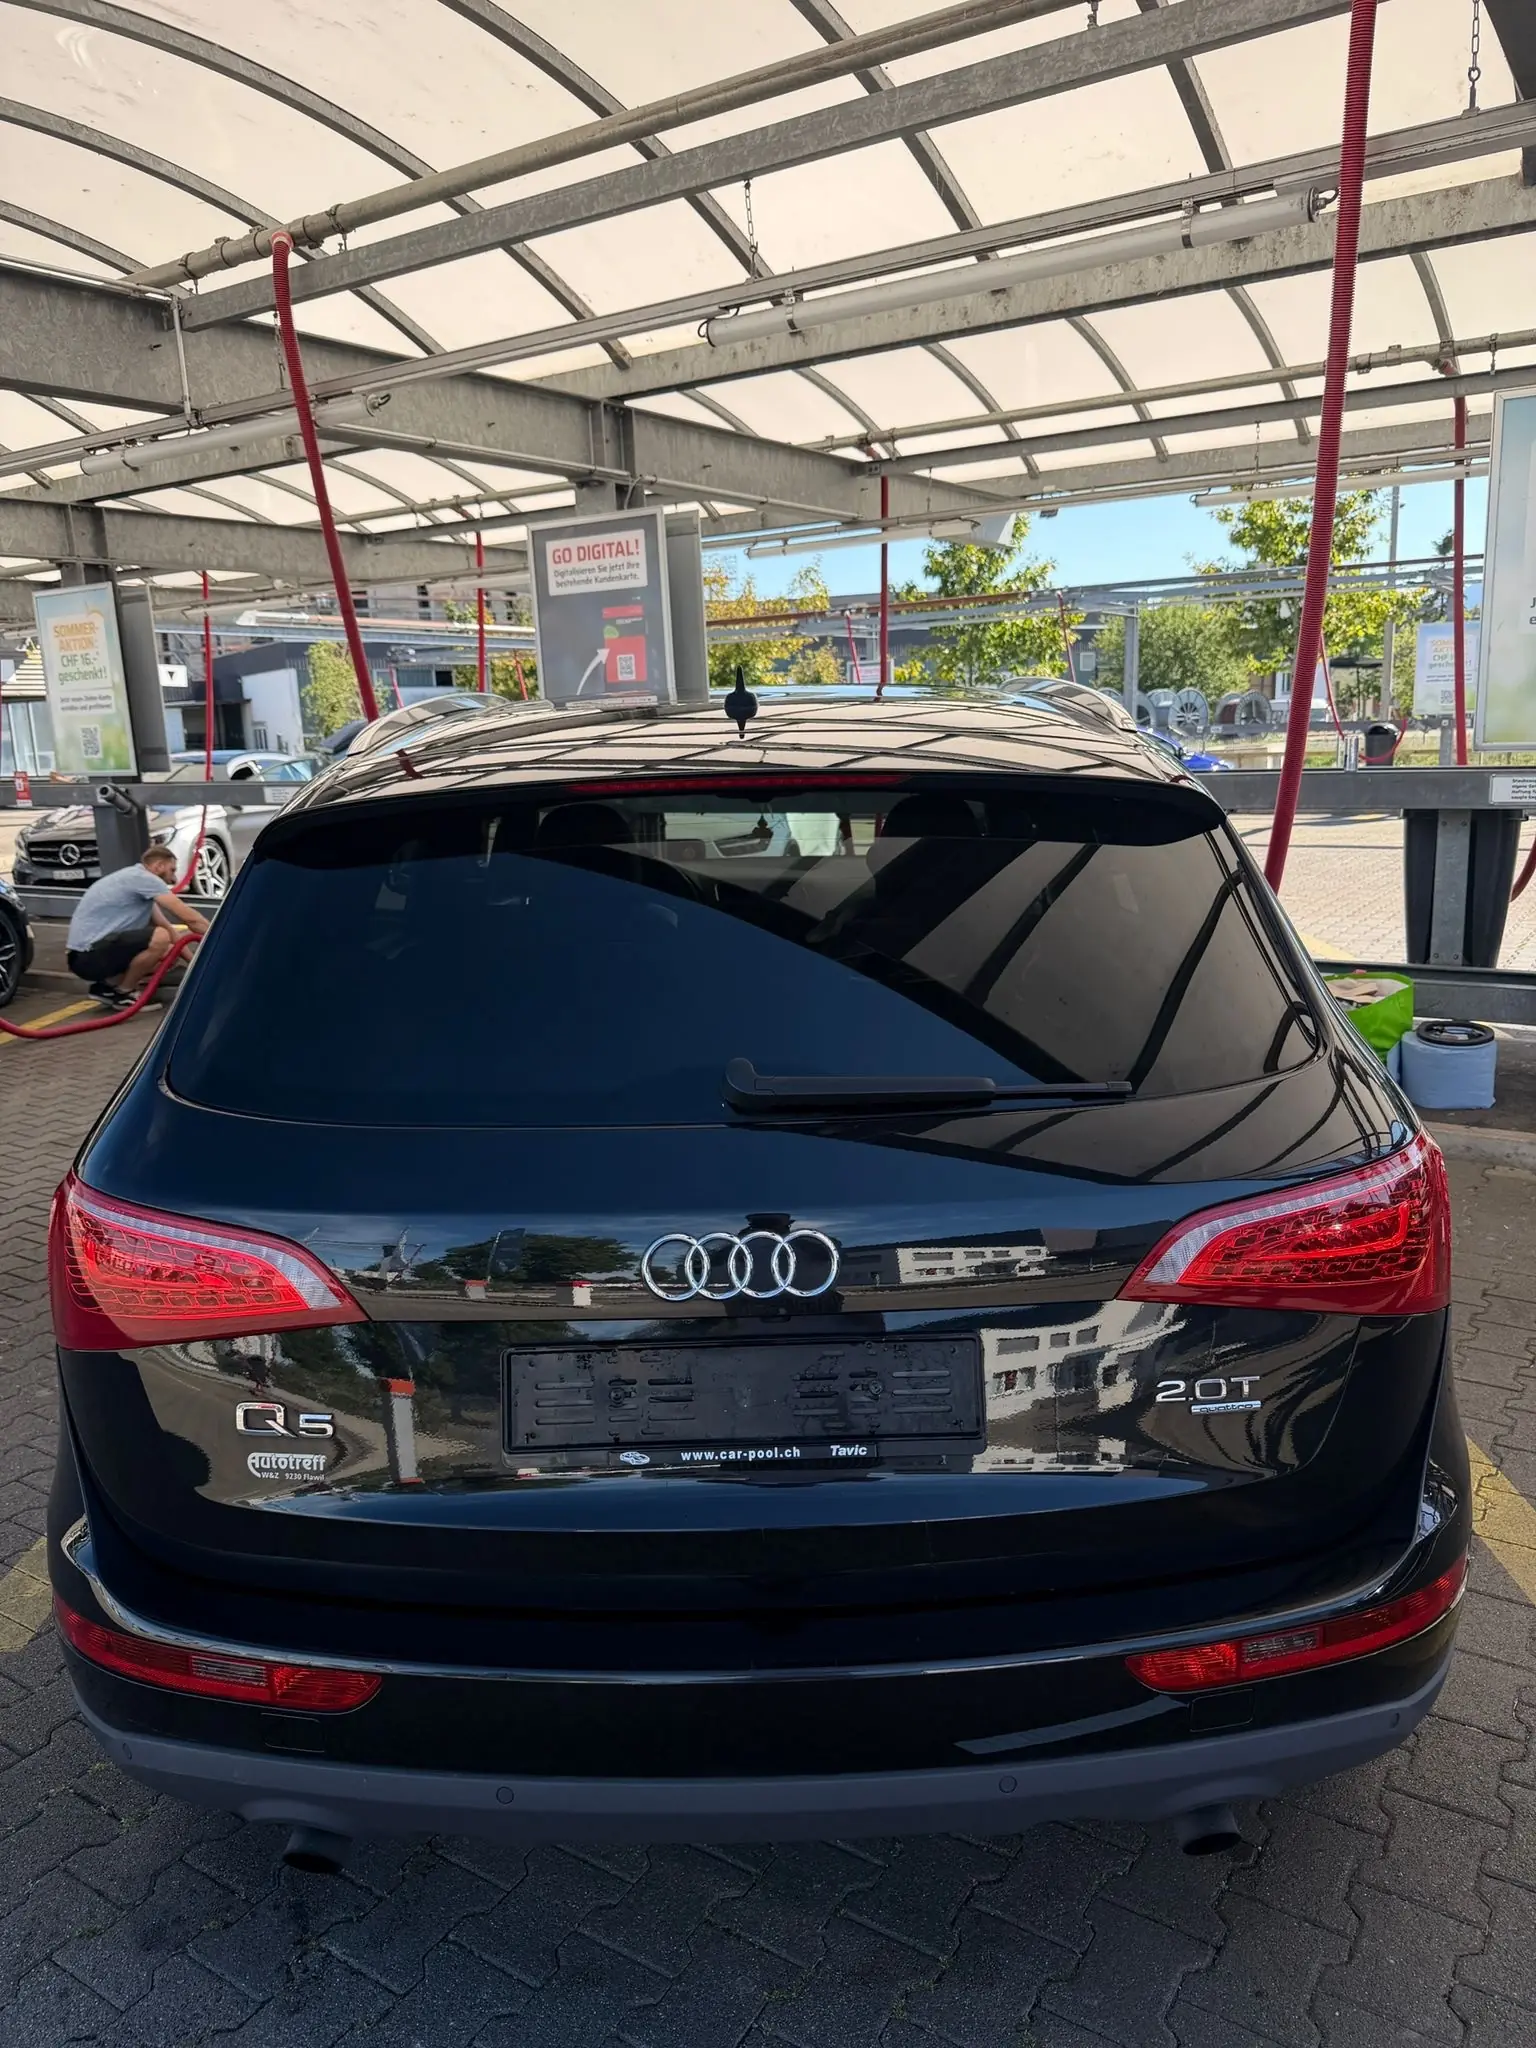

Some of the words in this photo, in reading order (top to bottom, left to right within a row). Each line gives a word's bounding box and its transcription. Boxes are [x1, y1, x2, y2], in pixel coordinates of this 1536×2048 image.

[552, 547, 572, 565] GO
[576, 539, 640, 562] DIGITAL!
[553, 567, 596, 579] Digitalisieren
[597, 564, 608, 573] Sie
[608, 562, 625, 574] jetzt
[626, 561, 640, 570] Ihre
[555, 577, 593, 589] bestehende
[594, 572, 640, 585] Kundenkarte.
[61, 653, 78, 668] CHF
[58, 666, 108, 686] geschenkt!
[1155, 1376, 1260, 1403] 2.0T
[1199, 1403, 1254, 1413] quattro
[235, 1402, 334, 1439] Q5
[680, 1446, 801, 1461] www.car-pool.ch
[830, 1444, 868, 1457] Tavic
[247, 1452, 327, 1477] Autotreff
[261, 1471, 280, 1480] W&Z
[284, 1472, 302, 1480] 9230
[303, 1473, 325, 1481] Flawil
